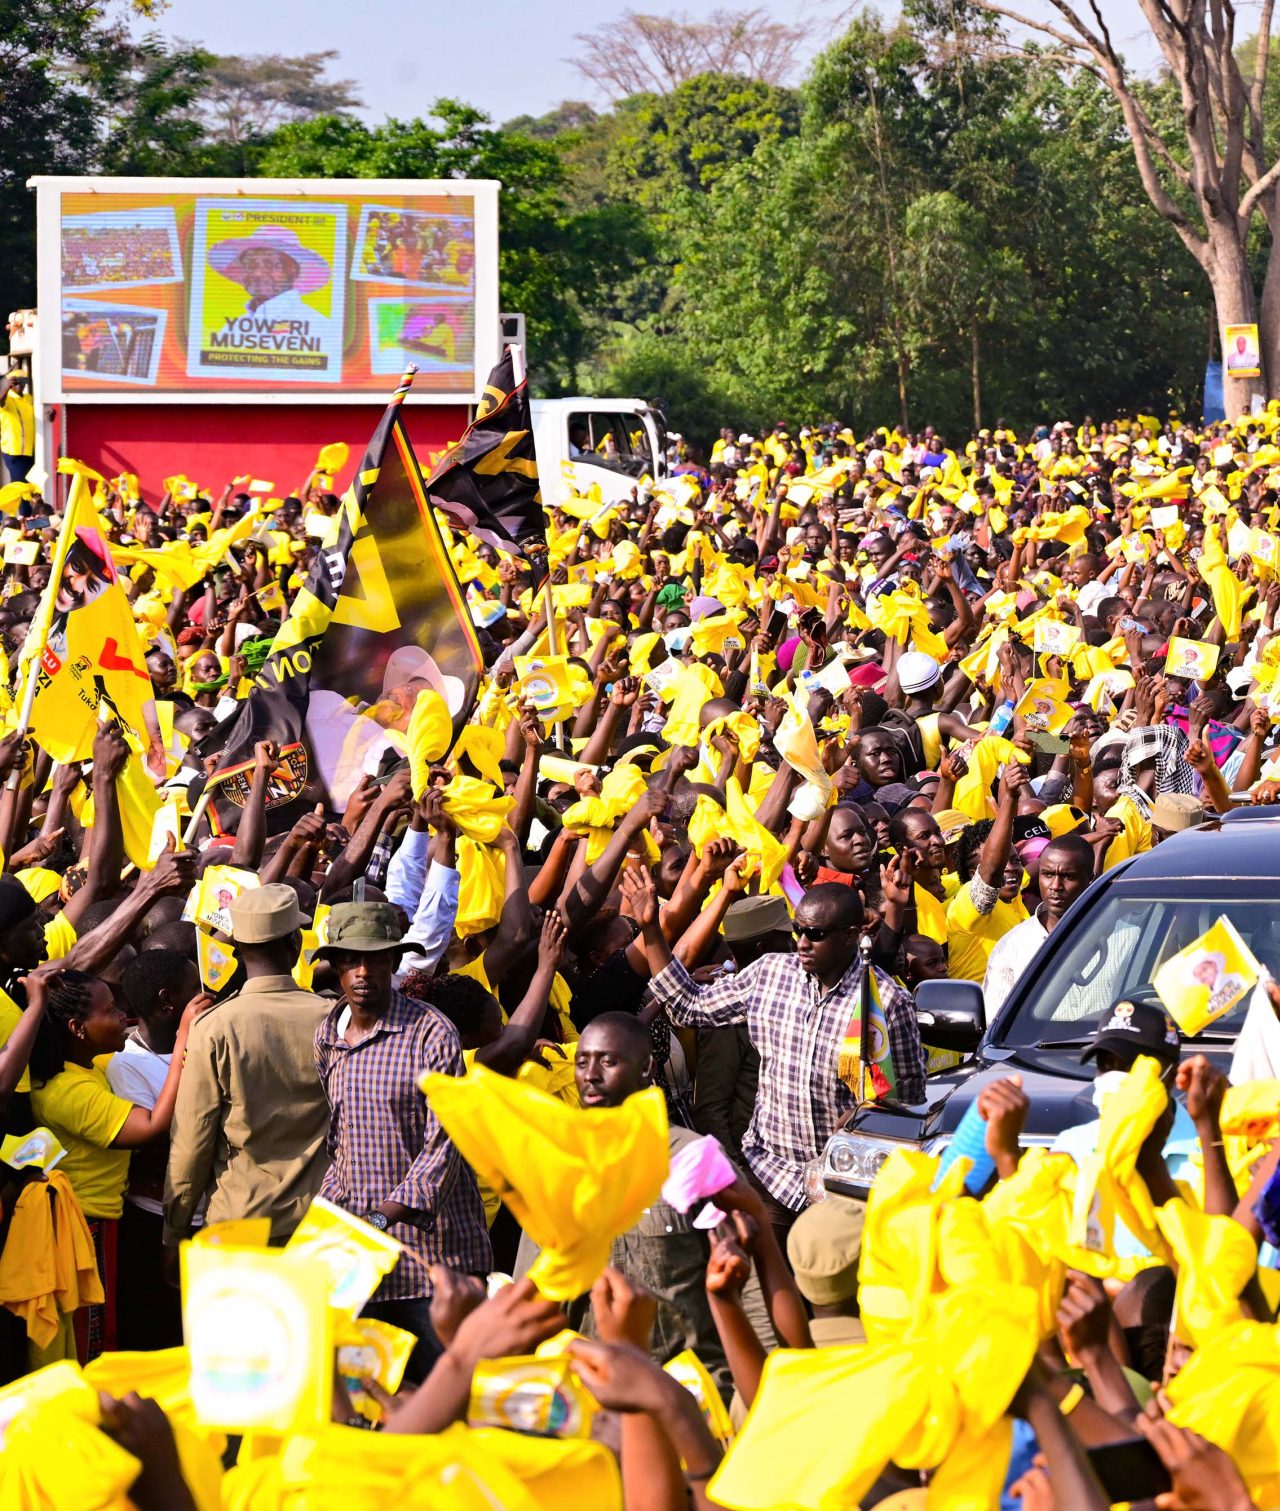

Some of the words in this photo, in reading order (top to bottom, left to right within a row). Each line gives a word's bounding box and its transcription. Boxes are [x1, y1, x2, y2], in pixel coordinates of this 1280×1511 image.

[247, 213, 311, 224] PRESIDENT
[224, 316, 309, 335] YOWERI
[210, 332, 321, 352] MUSEVENI
[208, 353, 268, 364] PROTECTING
[271, 356, 289, 364] THE
[292, 357, 321, 366] GAINS
